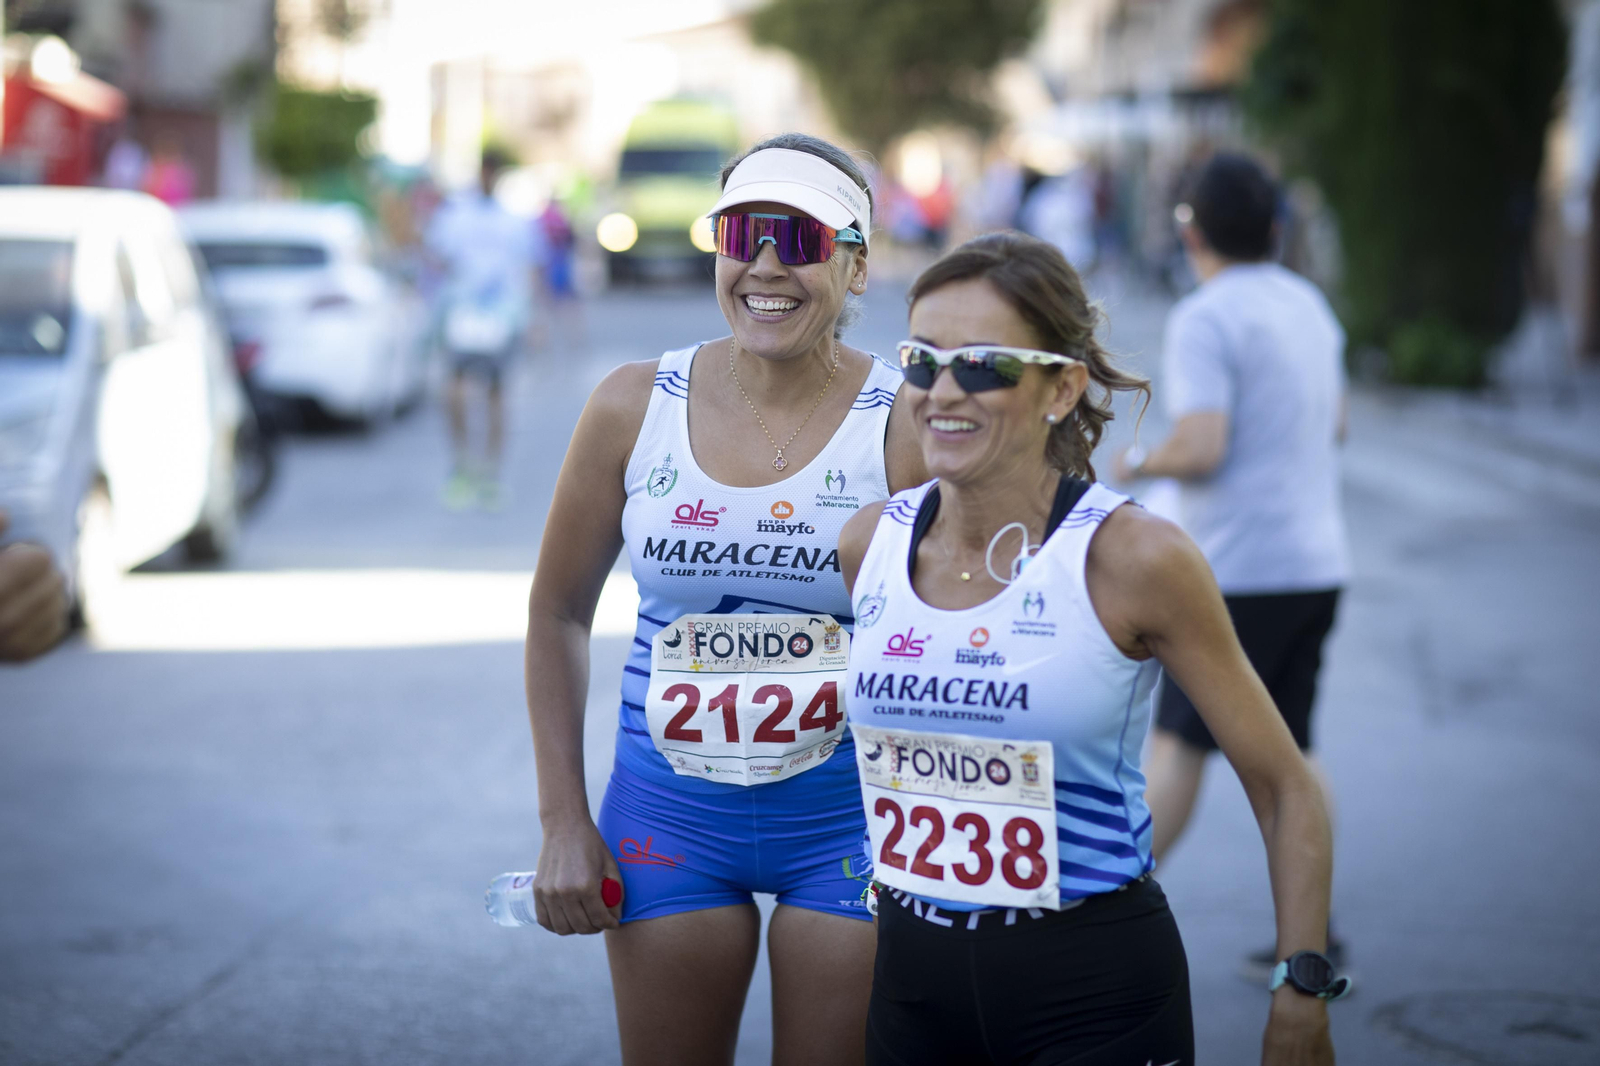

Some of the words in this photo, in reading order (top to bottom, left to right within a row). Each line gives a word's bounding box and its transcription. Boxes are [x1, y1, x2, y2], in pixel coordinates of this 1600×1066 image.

[837, 185, 861, 212] KIPRUN
[815, 493, 859, 502] Ayuntamiento
[822, 501, 860, 509] Maracena
[671, 499, 719, 527] als
[756, 522, 816, 536] mayfo
[643, 536, 841, 573] MARACENA
[661, 567, 697, 577] CLUB
[701, 569, 721, 577] DE
[725, 569, 816, 583] ATLETISMO
[693, 621, 734, 634] GRAN
[738, 622, 790, 634] PREMIO
[794, 626, 806, 634] DE
[694, 632, 814, 658] FONDO
[793, 640, 808, 651] 24
[882, 626, 925, 657] als
[955, 651, 1006, 668] mayfo
[855, 672, 1029, 711] MARACENA
[661, 681, 844, 743] 2124
[873, 705, 905, 716] CLUB
[909, 707, 925, 718] DE
[928, 708, 1005, 724] ATLETISMO
[893, 735, 932, 750] GRAN
[934, 740, 985, 758] PREMIO
[749, 764, 784, 772] Cruzcampo
[896, 745, 1011, 786] FONDO
[874, 797, 1047, 890] 2238
